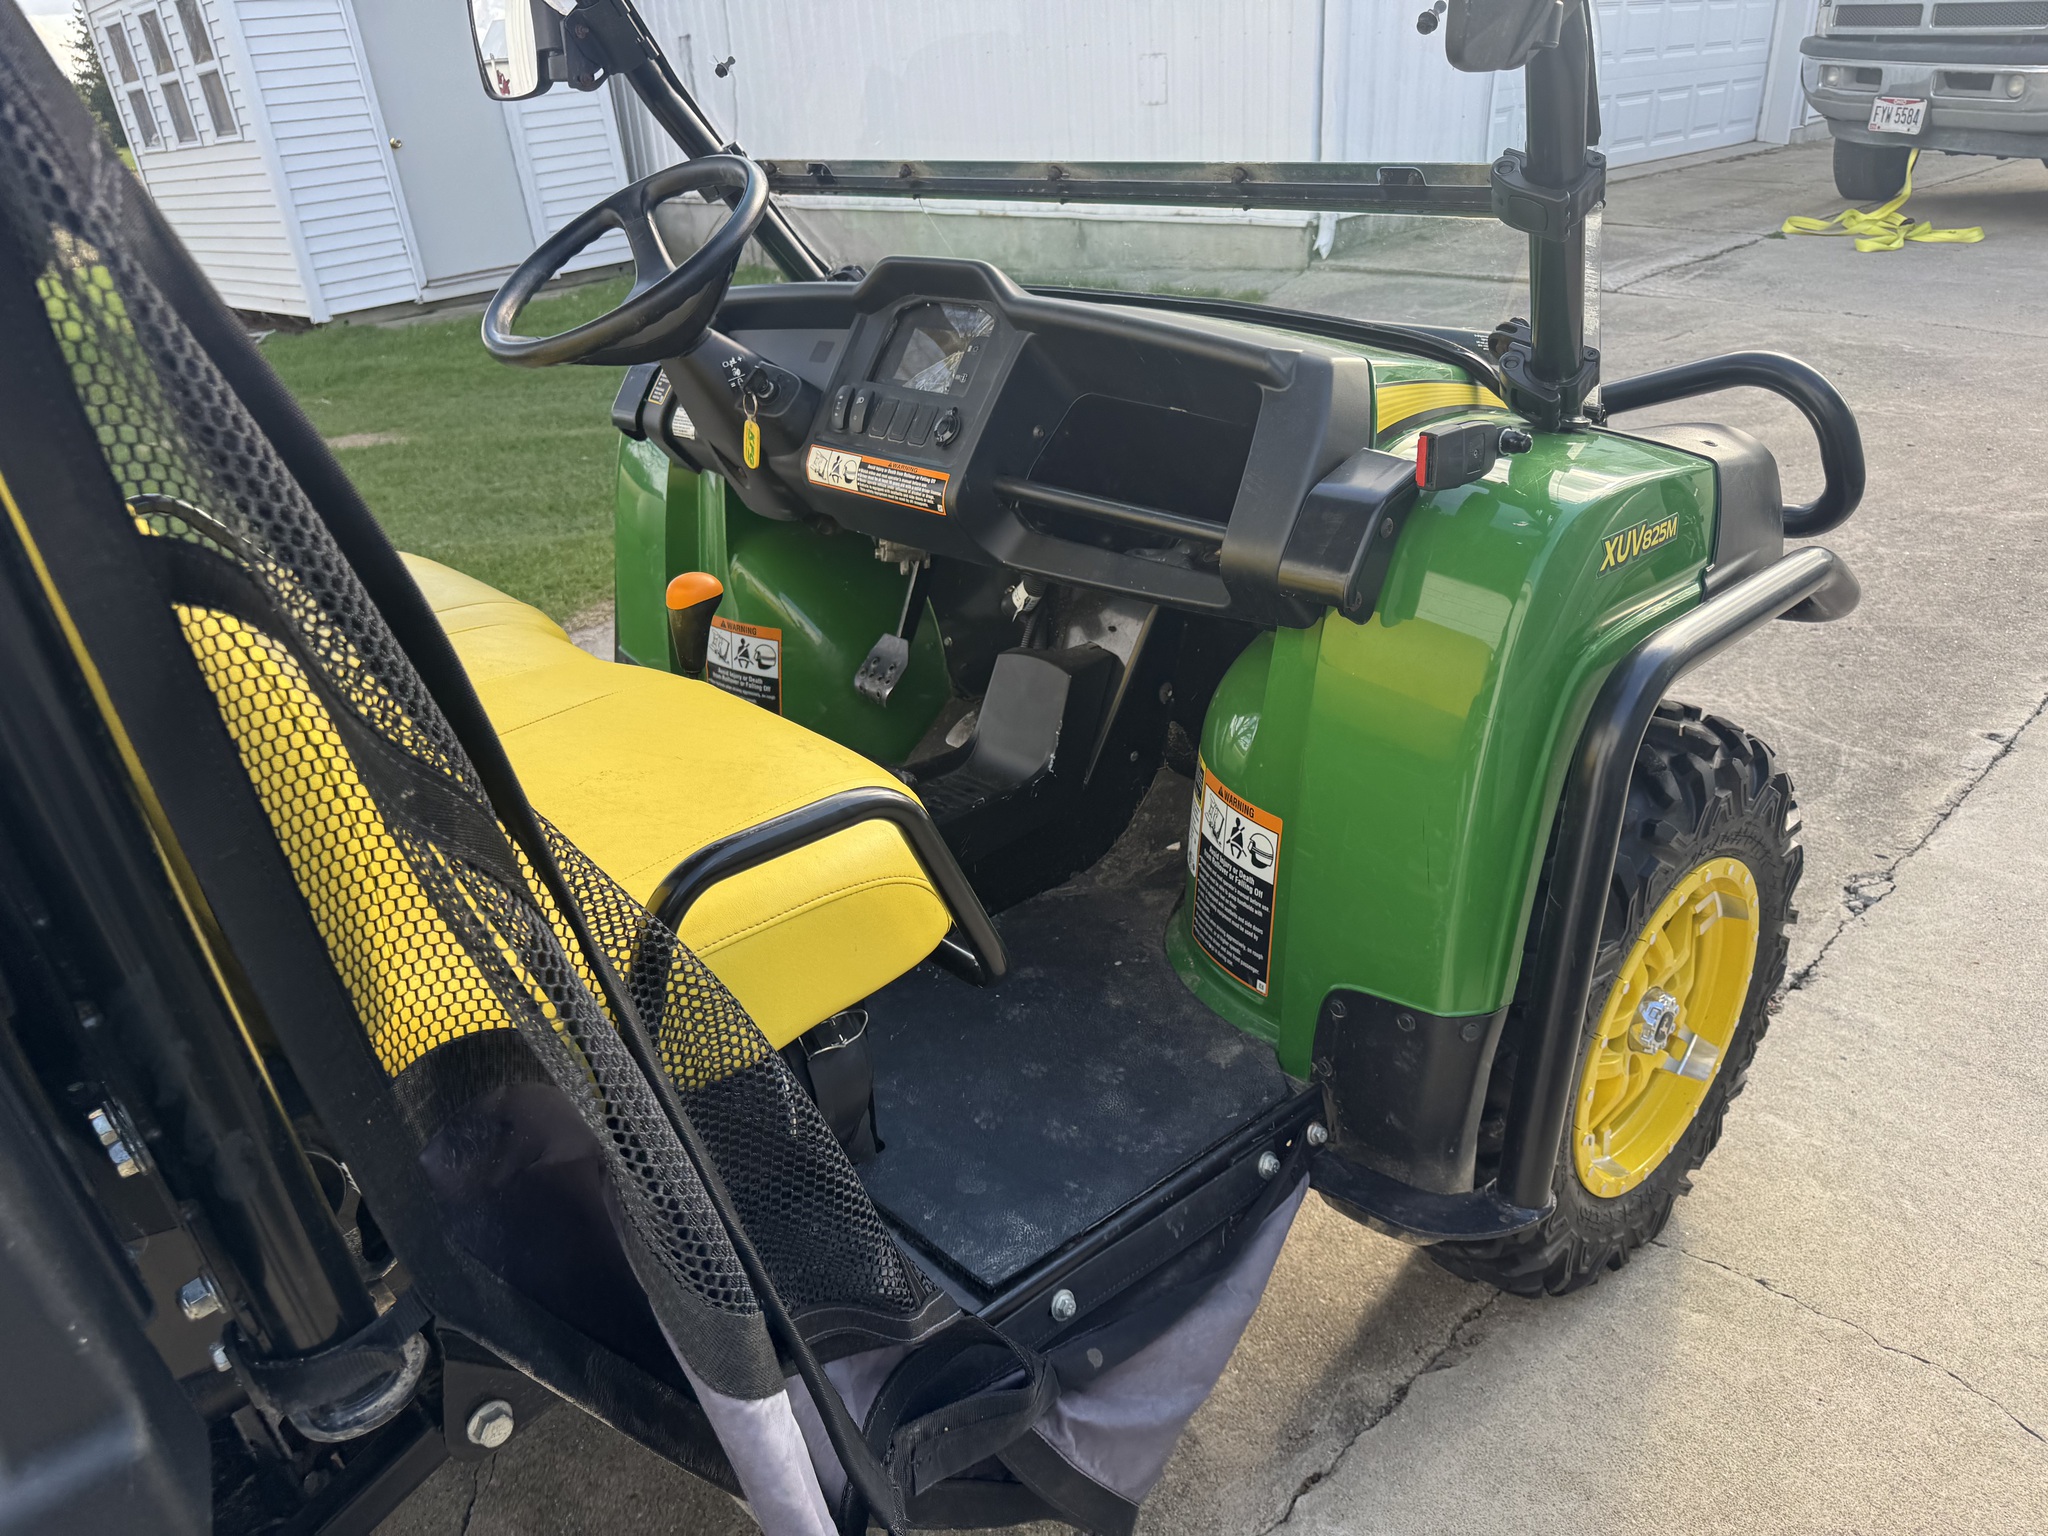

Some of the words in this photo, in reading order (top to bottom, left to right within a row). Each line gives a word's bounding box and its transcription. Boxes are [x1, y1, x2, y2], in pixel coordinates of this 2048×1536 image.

[1873, 106, 1893, 123] FYW
[1894, 108, 1920, 125] 5584
[892, 464, 918, 473] WARNING
[1600, 517, 1677, 571] XUV825M
[728, 622, 757, 635] WARNING
[746, 682, 762, 692] Falling
[749, 676, 763, 684] Death
[1224, 792, 1254, 819] WARNING
[1228, 871, 1234, 881] or
[1234, 876, 1253, 895] Falling
[1253, 888, 1263, 899] Off
[1232, 865, 1238, 875] or
[1238, 869, 1254, 886] Death
